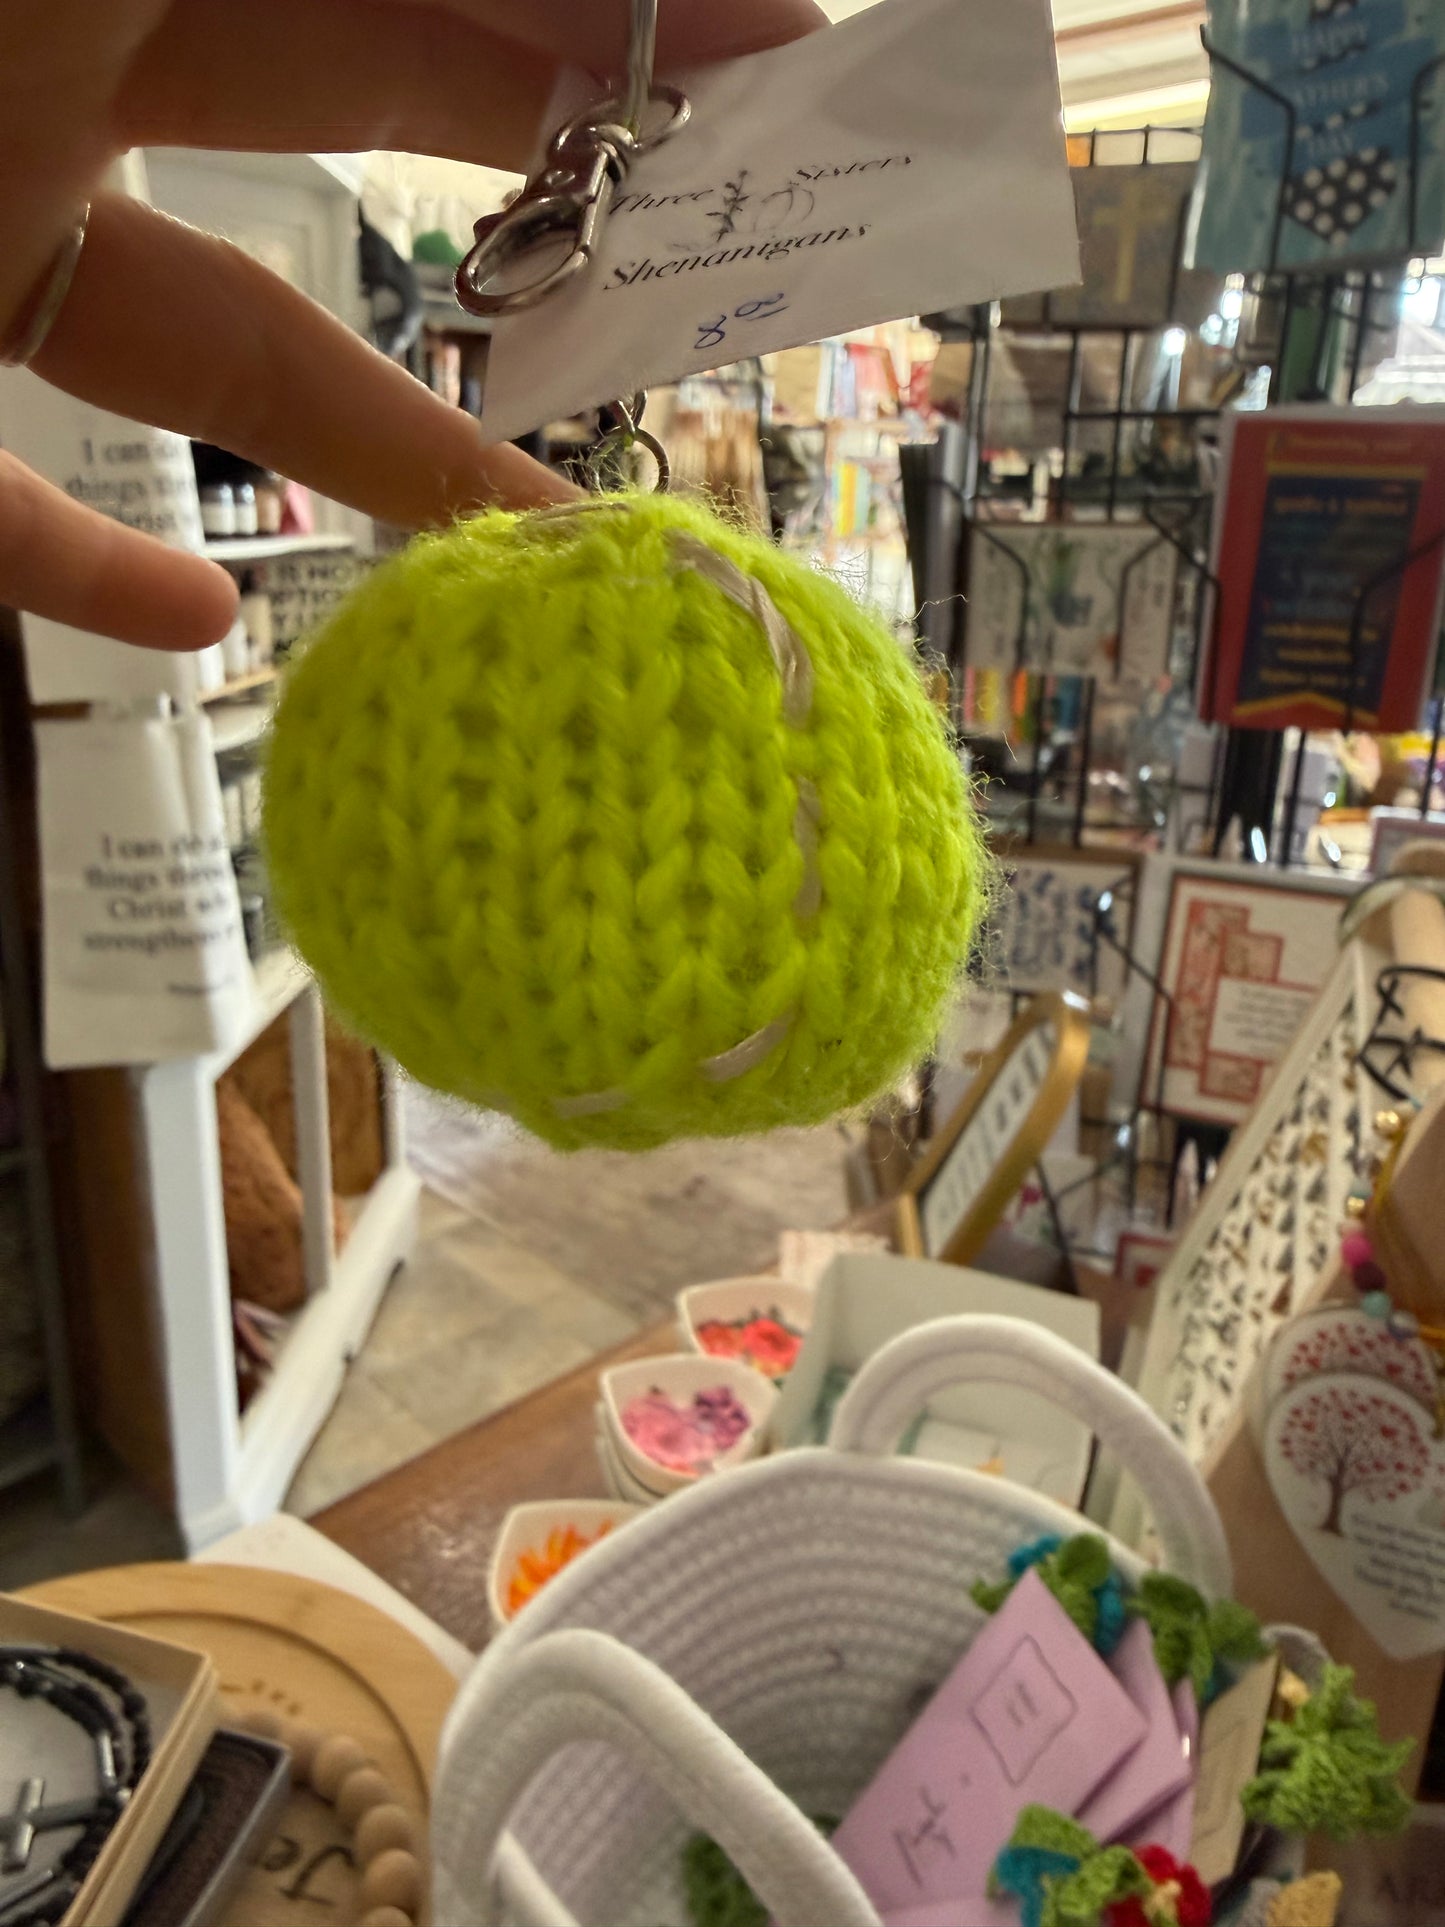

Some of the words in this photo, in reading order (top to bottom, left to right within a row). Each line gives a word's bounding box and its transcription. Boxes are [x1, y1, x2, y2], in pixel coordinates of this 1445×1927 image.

[608, 188, 715, 216] Three
[795, 153, 913, 182] Sisters
[602, 223, 872, 291] Shenanigans
